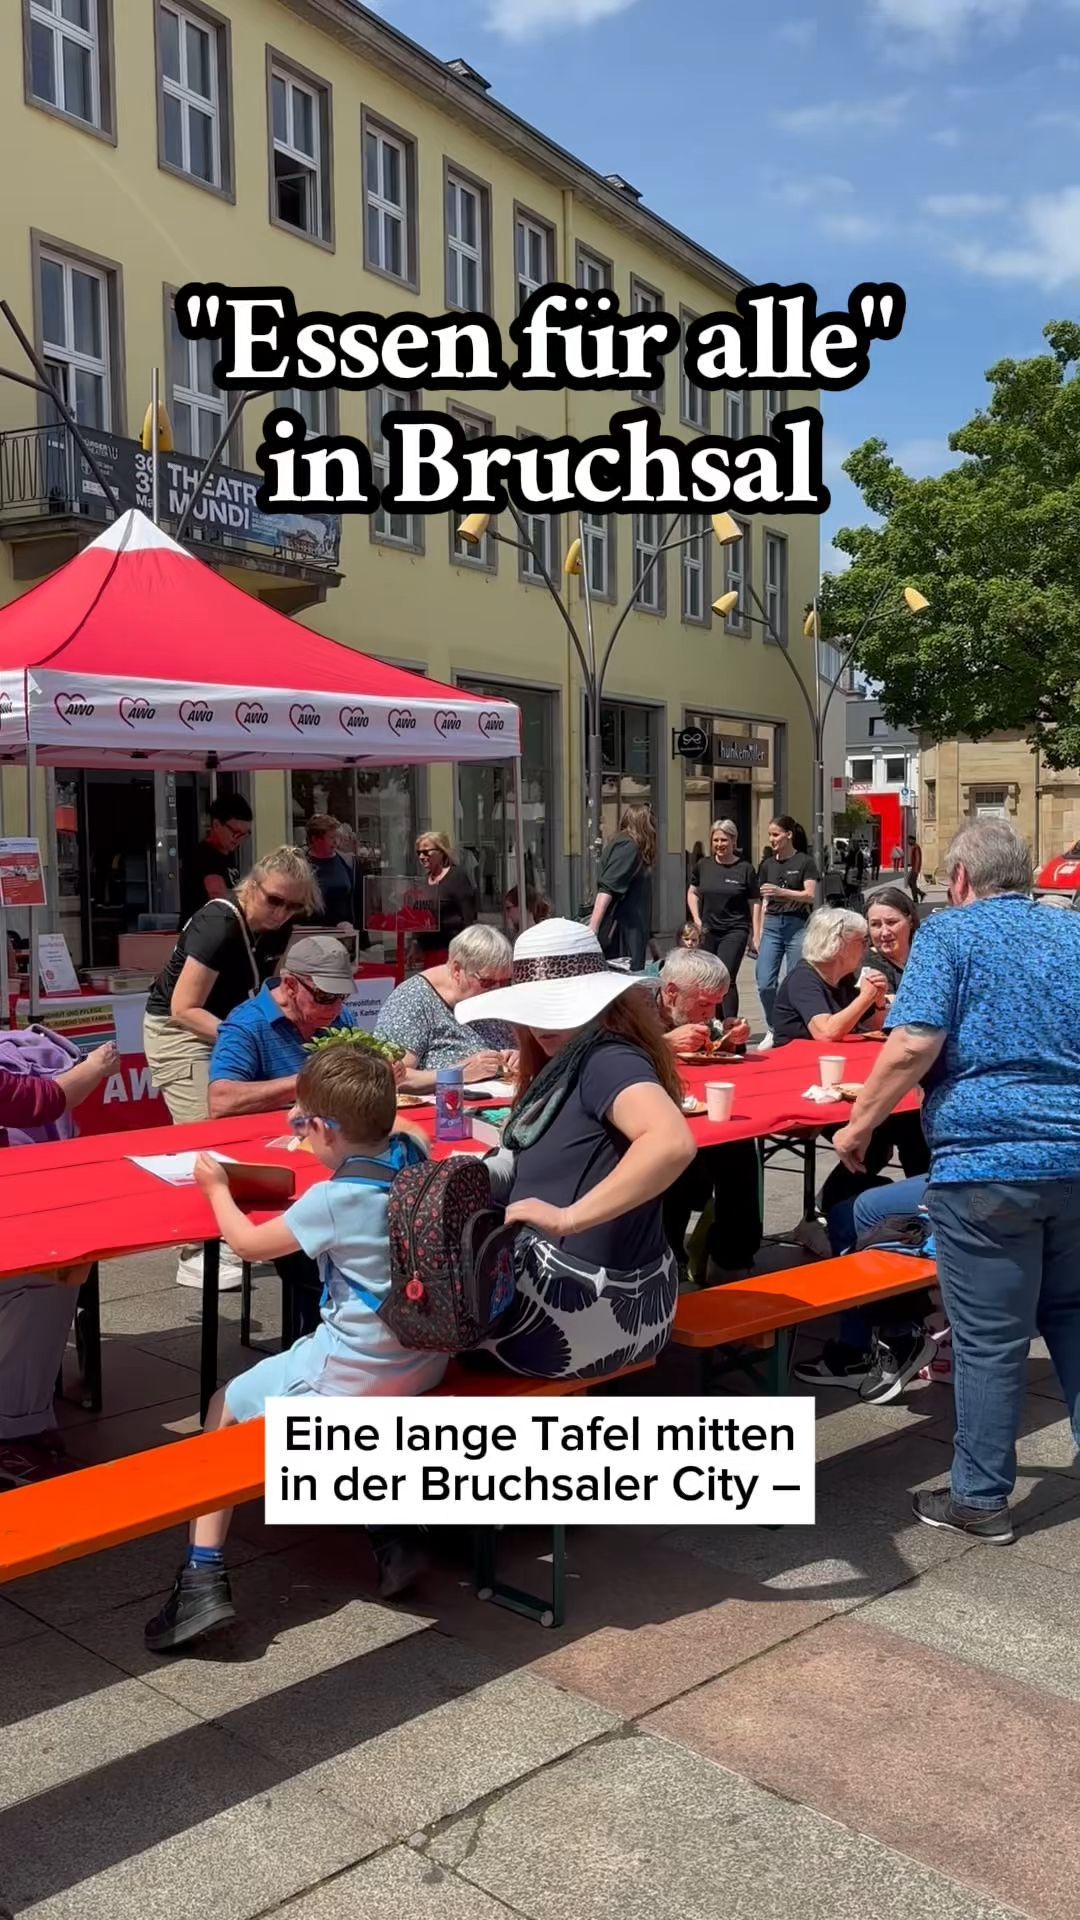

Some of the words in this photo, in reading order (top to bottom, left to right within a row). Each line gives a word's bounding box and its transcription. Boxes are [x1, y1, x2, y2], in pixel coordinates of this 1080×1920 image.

[167, 462, 258, 507] THEATR
[169, 490, 250, 529] MUNDI
[65, 704, 95, 716] AWO
[127, 707, 156, 720] AWO
[187, 710, 214, 722] AWO
[243, 712, 269, 725] AWO
[296, 713, 321, 726] AWO
[346, 715, 369, 728] AWO
[395, 717, 417, 729] AWO
[440, 719, 462, 730] AWO
[484, 720, 504, 731] AWO
[720, 740, 765, 761] hunkemöller
[103, 1067, 161, 1104] AW
